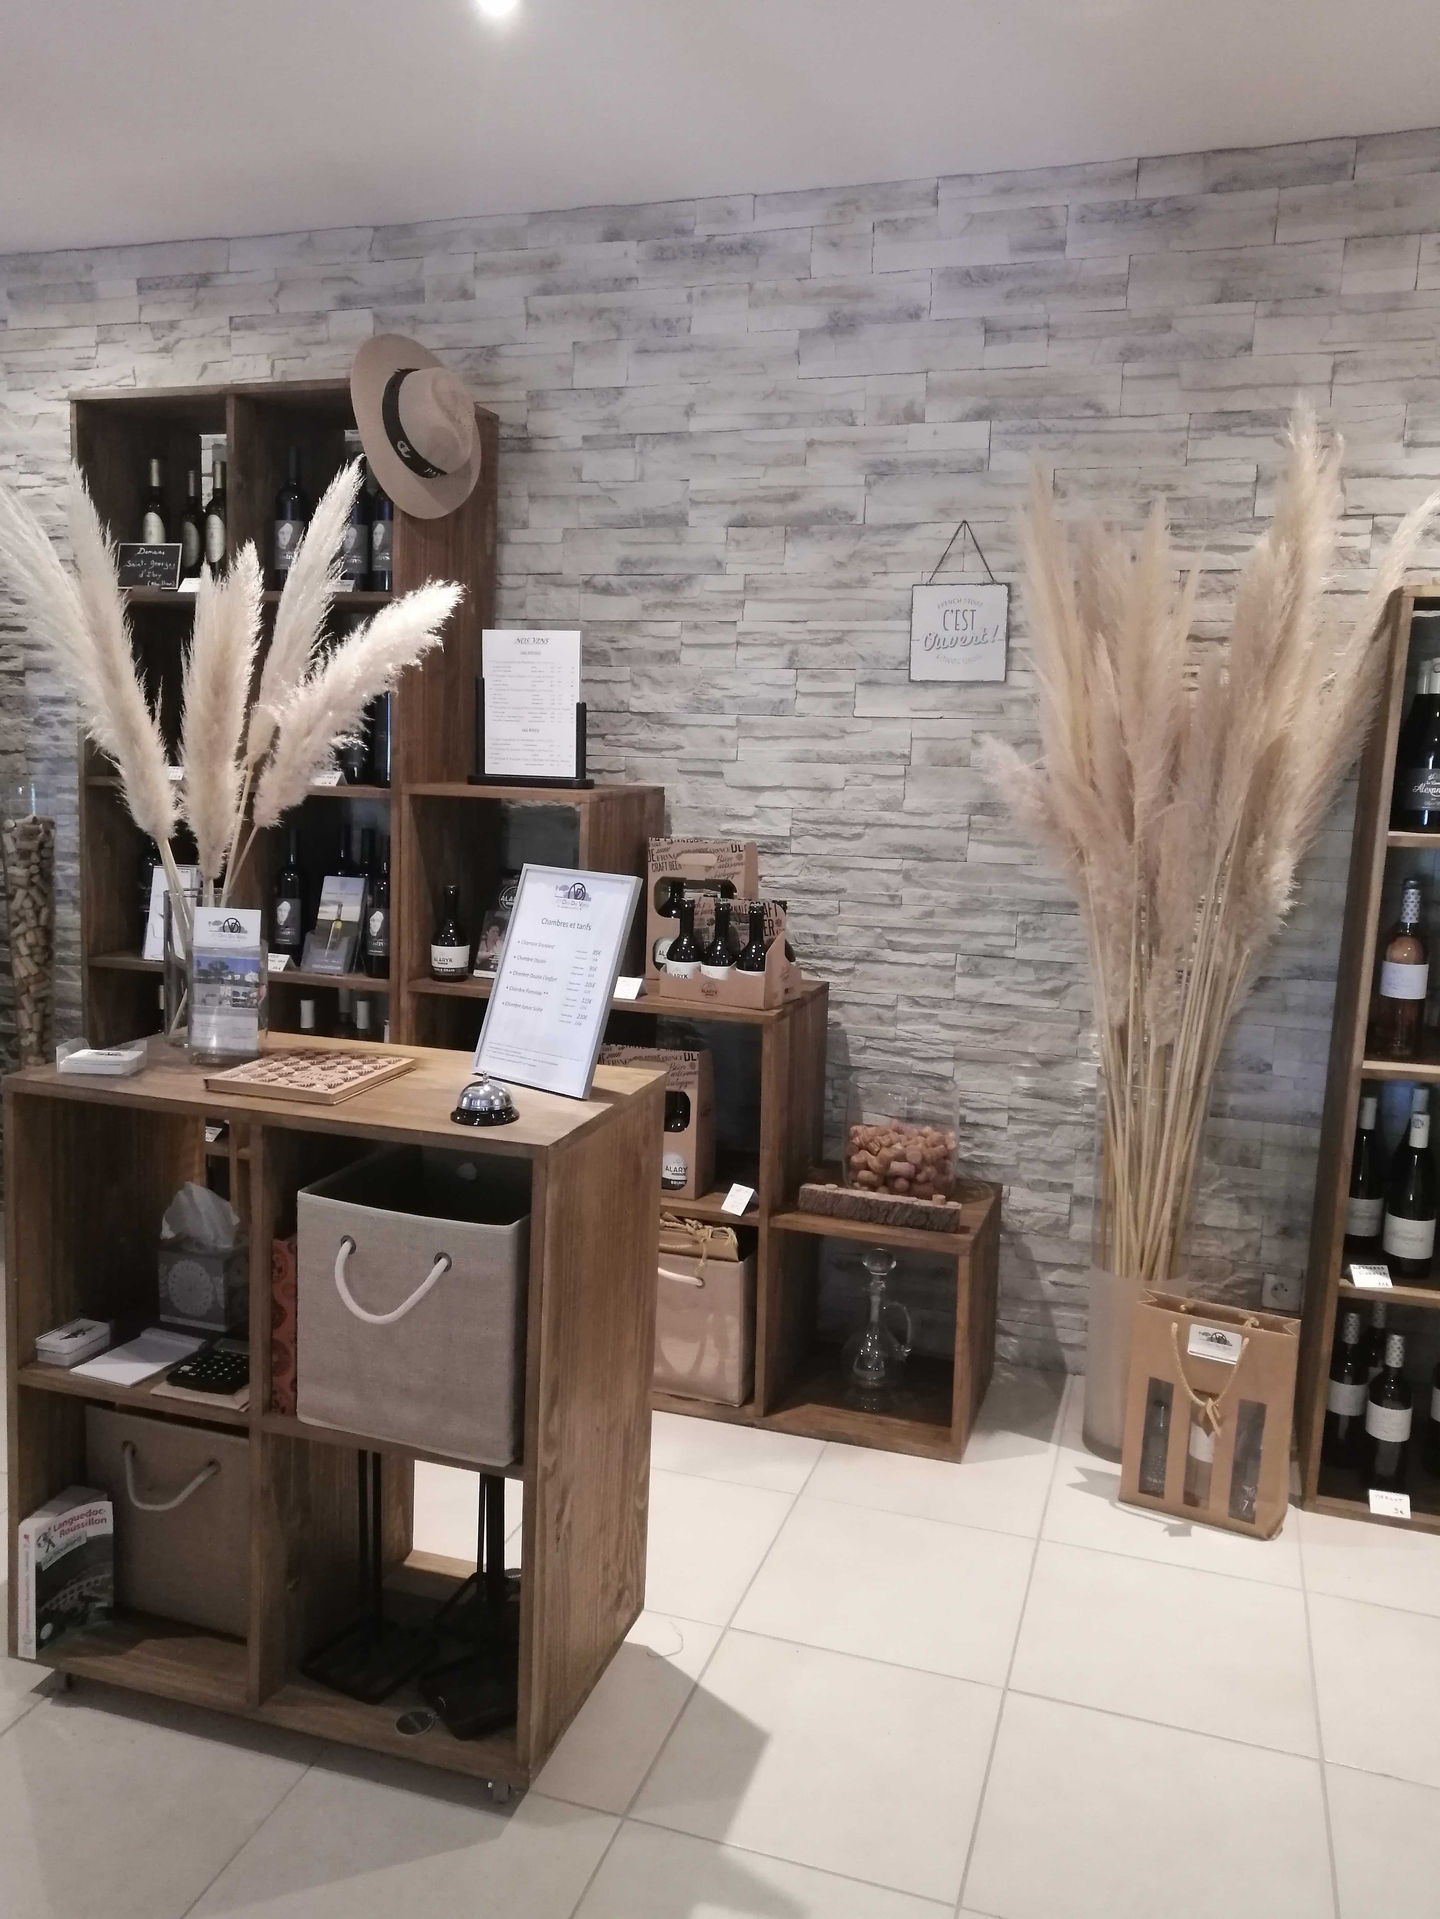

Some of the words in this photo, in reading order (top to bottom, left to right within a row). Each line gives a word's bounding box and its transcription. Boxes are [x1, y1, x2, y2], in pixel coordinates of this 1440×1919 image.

[942, 609, 977, 632] C'EST
[541, 917, 569, 929] Chambres
[665, 1165, 687, 1173] ALARY
[59, 1517, 107, 1538] Roussillon
